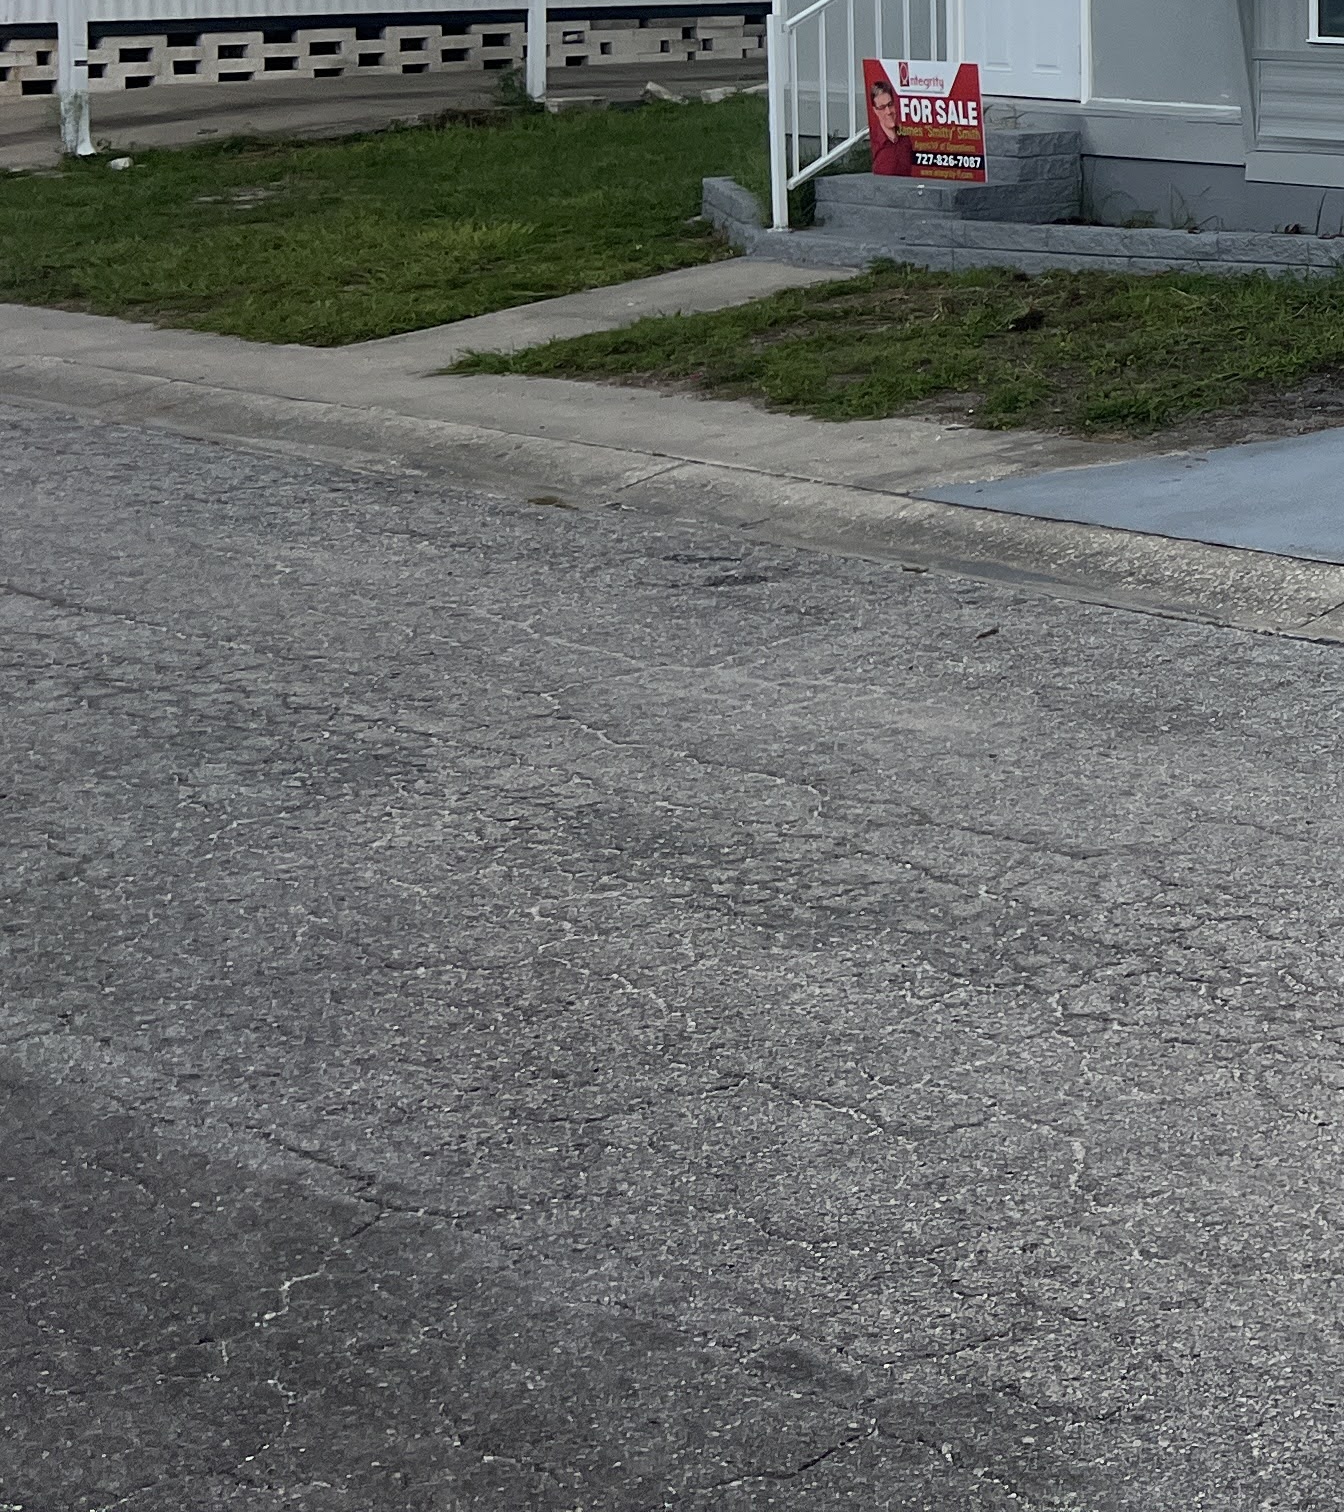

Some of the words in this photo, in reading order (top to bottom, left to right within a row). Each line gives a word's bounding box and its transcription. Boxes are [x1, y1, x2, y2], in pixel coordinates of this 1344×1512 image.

[900, 97, 933, 124] FOR
[935, 99, 978, 126] SALE
[897, 123, 923, 136] James
[957, 126, 981, 140] Smith
[915, 152, 981, 168] 727-826-7087
